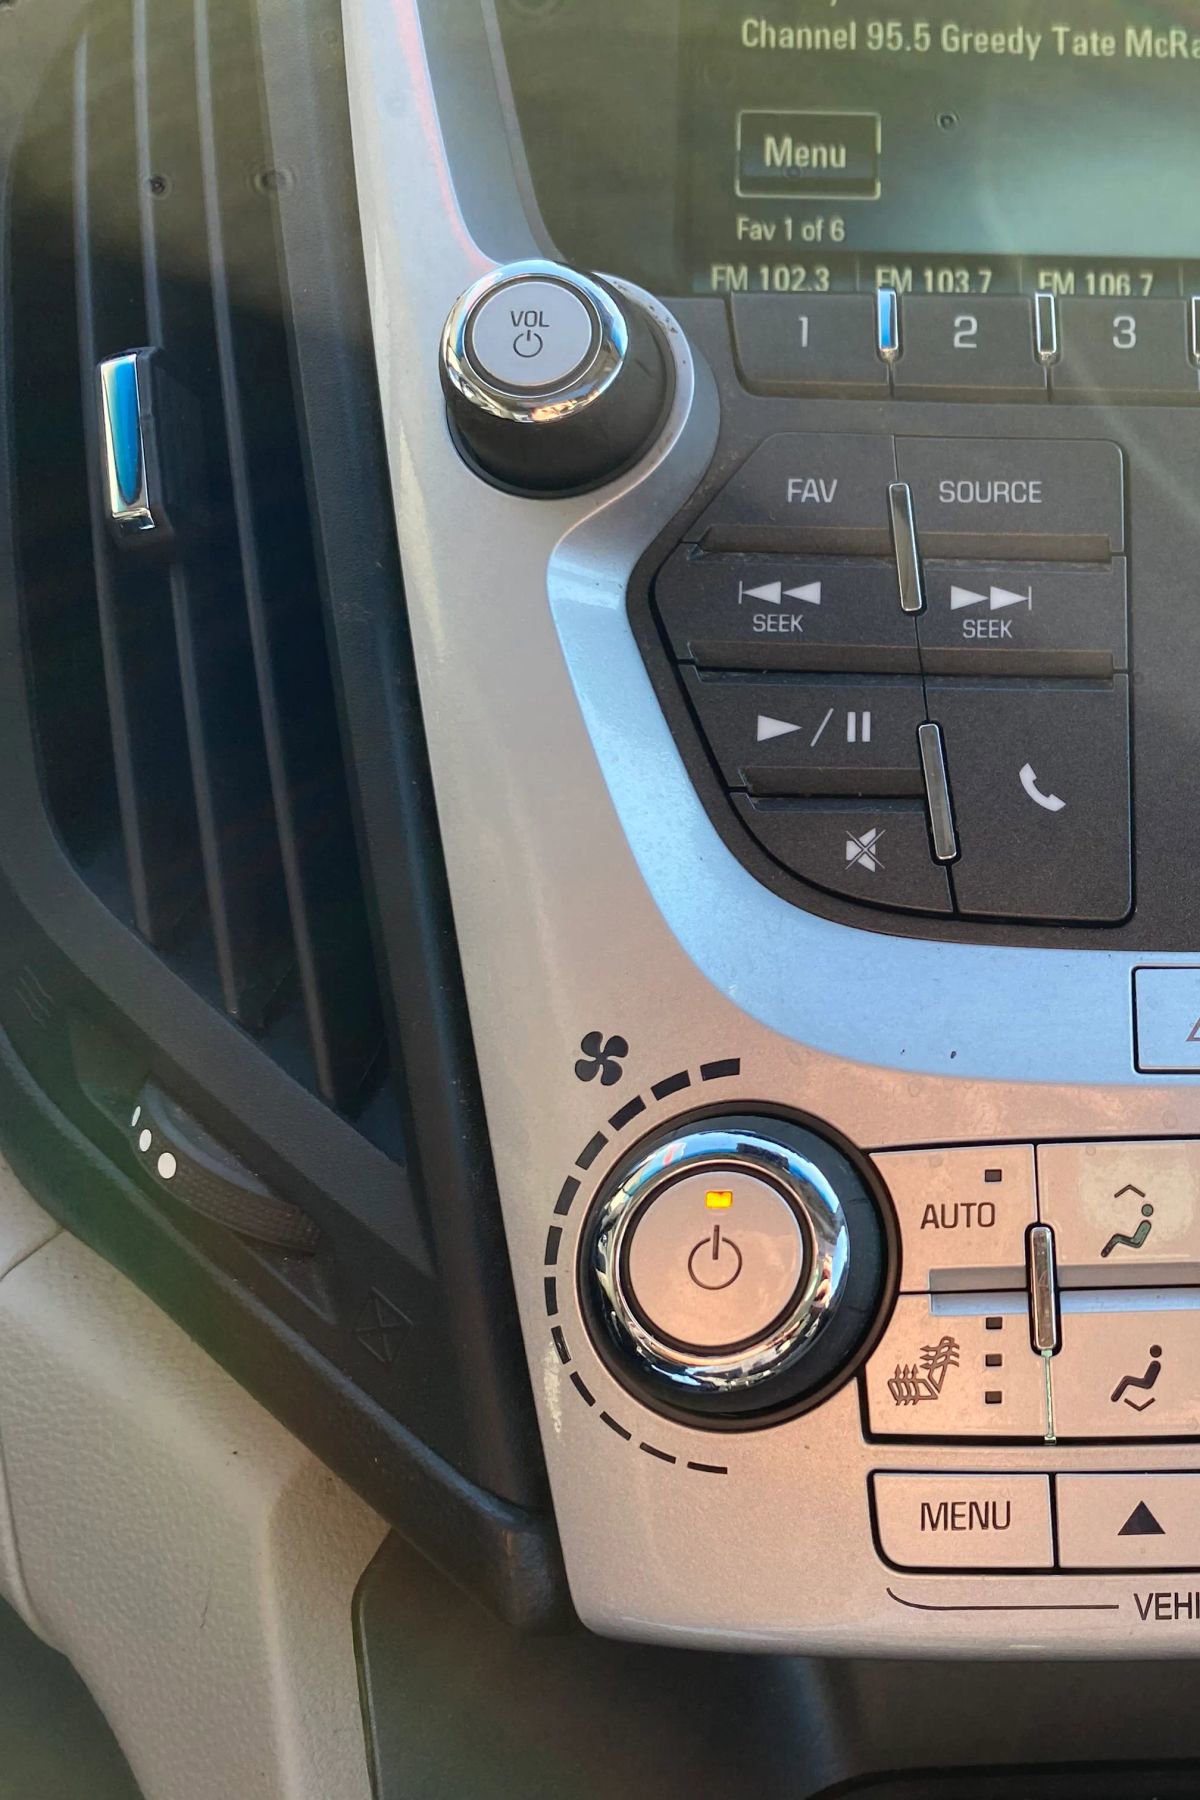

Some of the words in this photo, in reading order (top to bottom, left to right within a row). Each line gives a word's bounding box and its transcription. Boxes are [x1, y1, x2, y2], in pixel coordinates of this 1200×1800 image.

[741, 18, 856, 51] Channel
[866, 21, 931, 52] 95.5
[941, 24, 1041, 61] Greedy
[1051, 26, 1116, 56] Tate
[763, 136, 847, 168] Menu
[737, 218, 776, 240] Fav
[784, 219, 792, 241] 1
[801, 219, 823, 241] of
[830, 220, 845, 242] 6
[711, 265, 748, 290] FM
[760, 266, 830, 291] 102.3
[876, 267, 912, 292] FM
[1038, 271, 1075, 295] FM
[510, 310, 549, 328] VOL
[798, 316, 810, 348] 1
[954, 317, 978, 348] 2
[1112, 316, 1137, 349] 3
[786, 478, 838, 504] FAV
[938, 480, 1043, 505] SOURCE
[752, 614, 804, 633] SEEK
[962, 618, 1013, 640] SEEK
[920, 1202, 996, 1229] AUTO
[920, 1500, 1013, 1531] MENU
